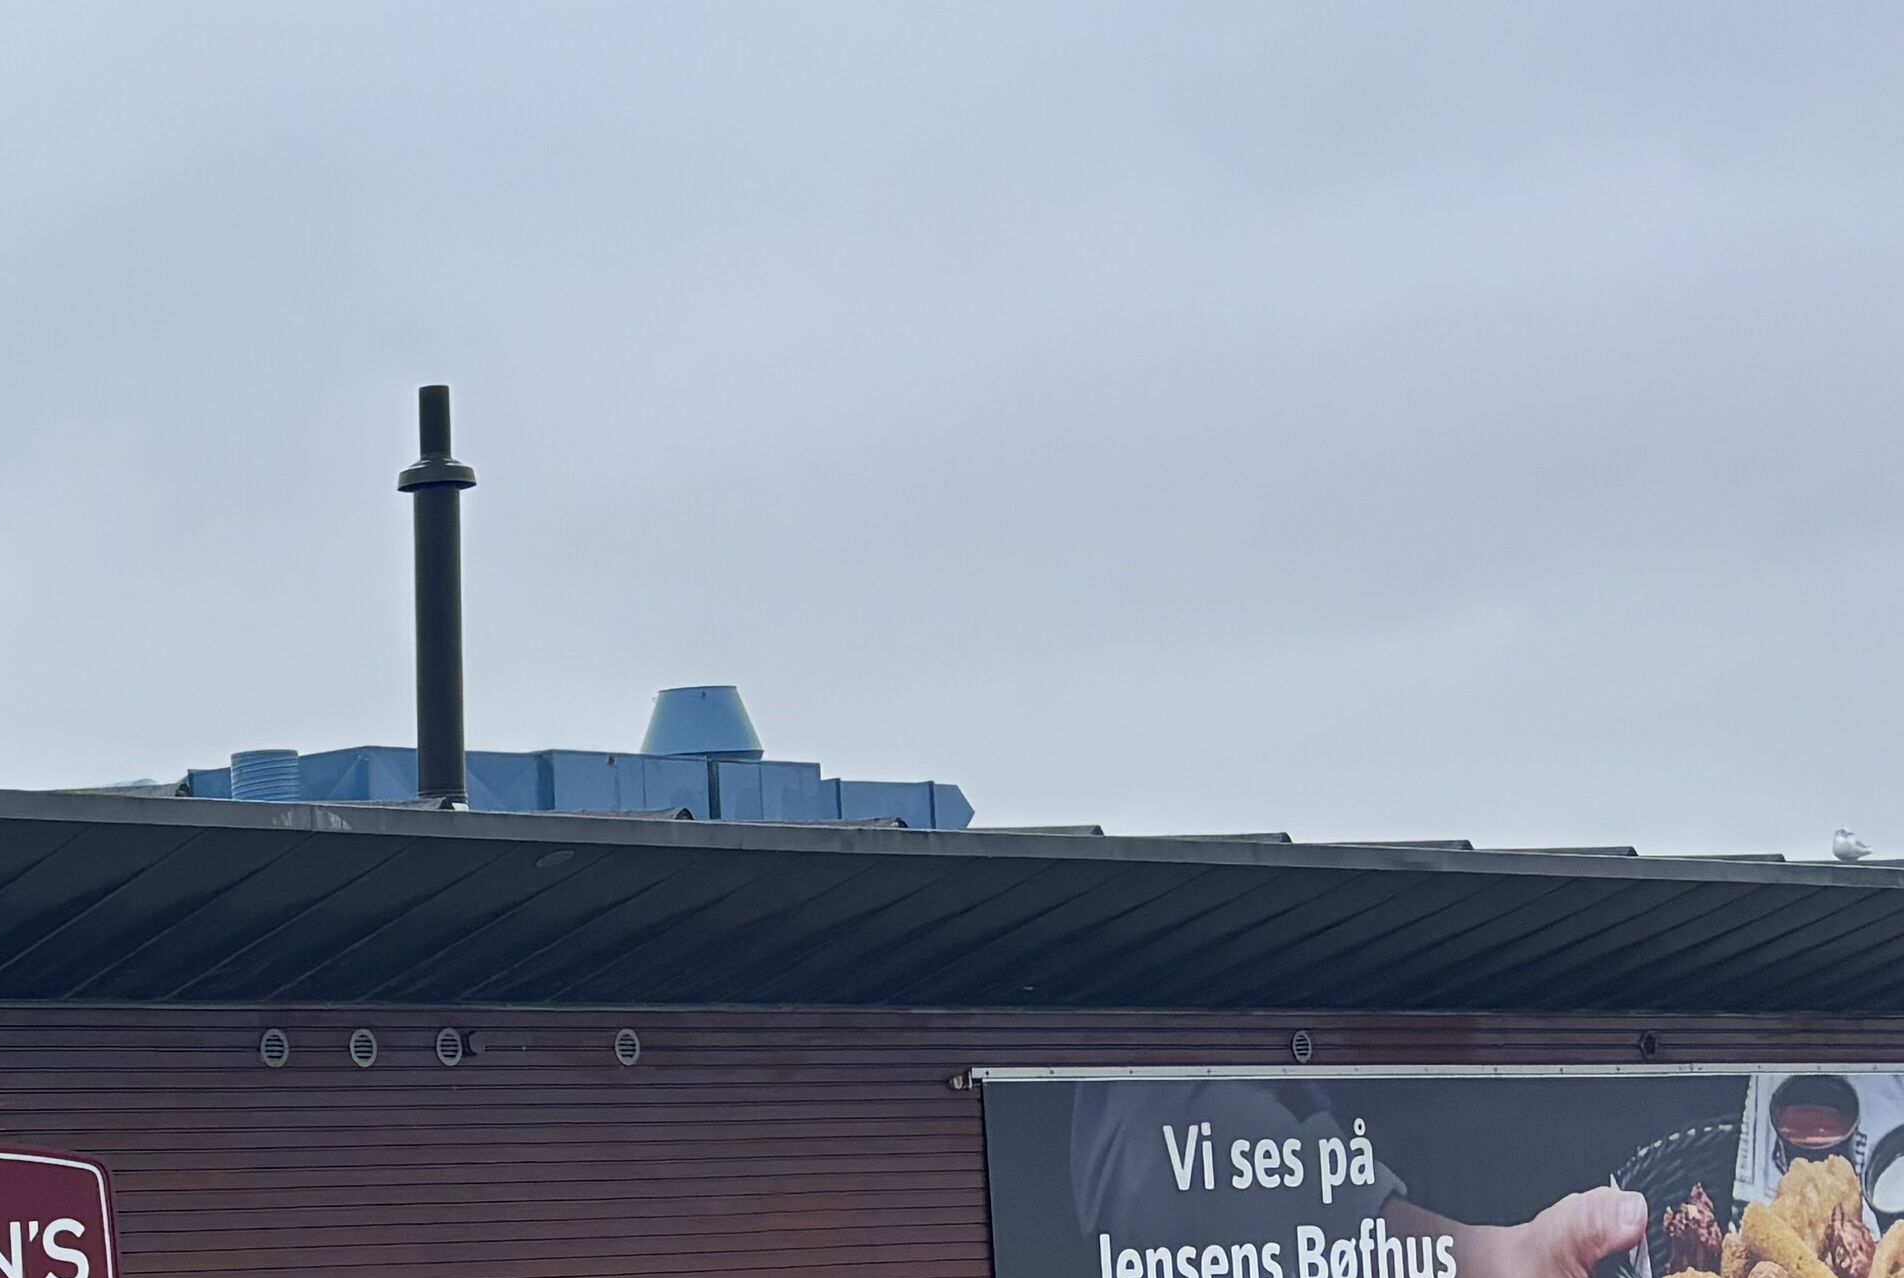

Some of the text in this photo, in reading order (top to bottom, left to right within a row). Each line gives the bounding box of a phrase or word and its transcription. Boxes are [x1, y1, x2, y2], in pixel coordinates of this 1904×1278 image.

[1162, 1117, 1376, 1204] Vi ses på
